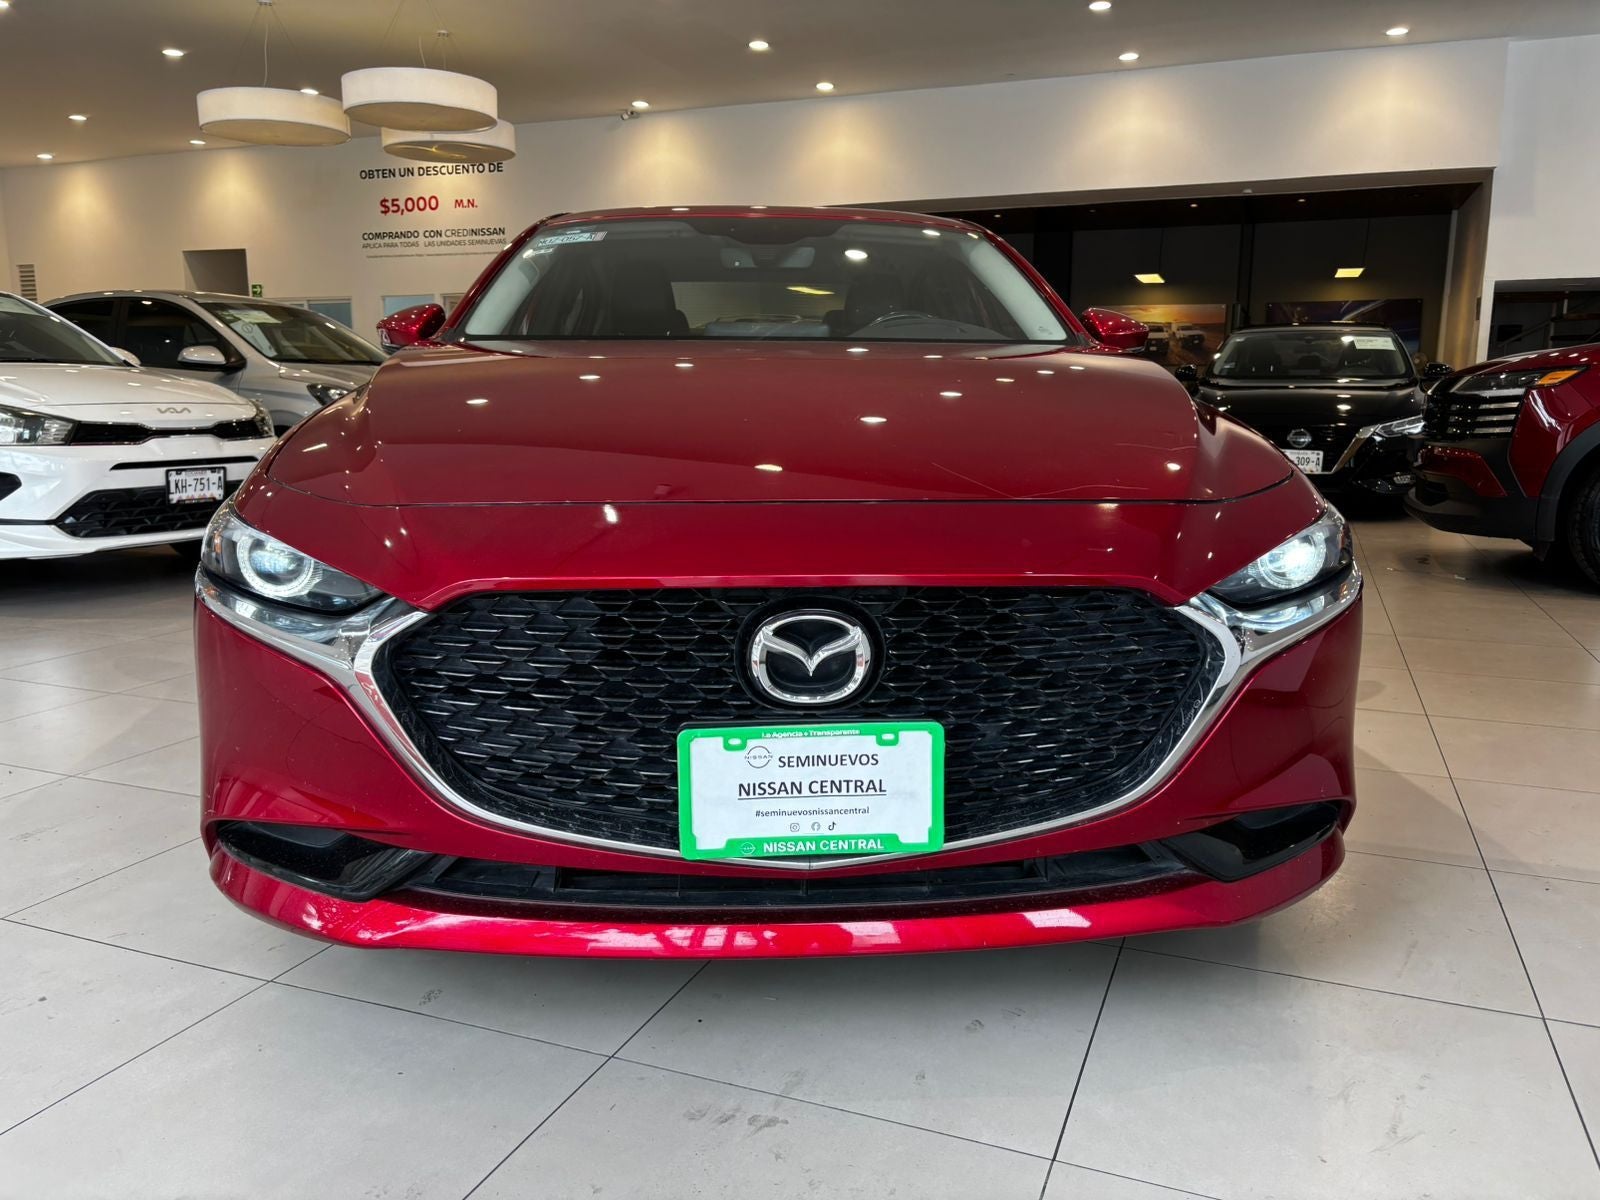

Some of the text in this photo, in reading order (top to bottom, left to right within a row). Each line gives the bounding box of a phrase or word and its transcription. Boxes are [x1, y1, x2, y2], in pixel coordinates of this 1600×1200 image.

[359, 162, 504, 180] OBTEN UN DESCUENTO DE
[379, 195, 478, 216] $5,000 M.N.
[362, 227, 506, 241] COMPRANDO CON CREDINISSAN
[436, 239, 467, 247] UNIDADES
[467, 238, 507, 246] SEMINUEVAS
[169, 476, 223, 495] LKH-751-A
[778, 753, 879, 768] SEMINUEVOS
[738, 779, 887, 797] NISSAN CENTRAL
[755, 806, 870, 817] #seminuevosnissancentral
[763, 841, 817, 853] NISSAN
[821, 839, 884, 851] CENTRAL
